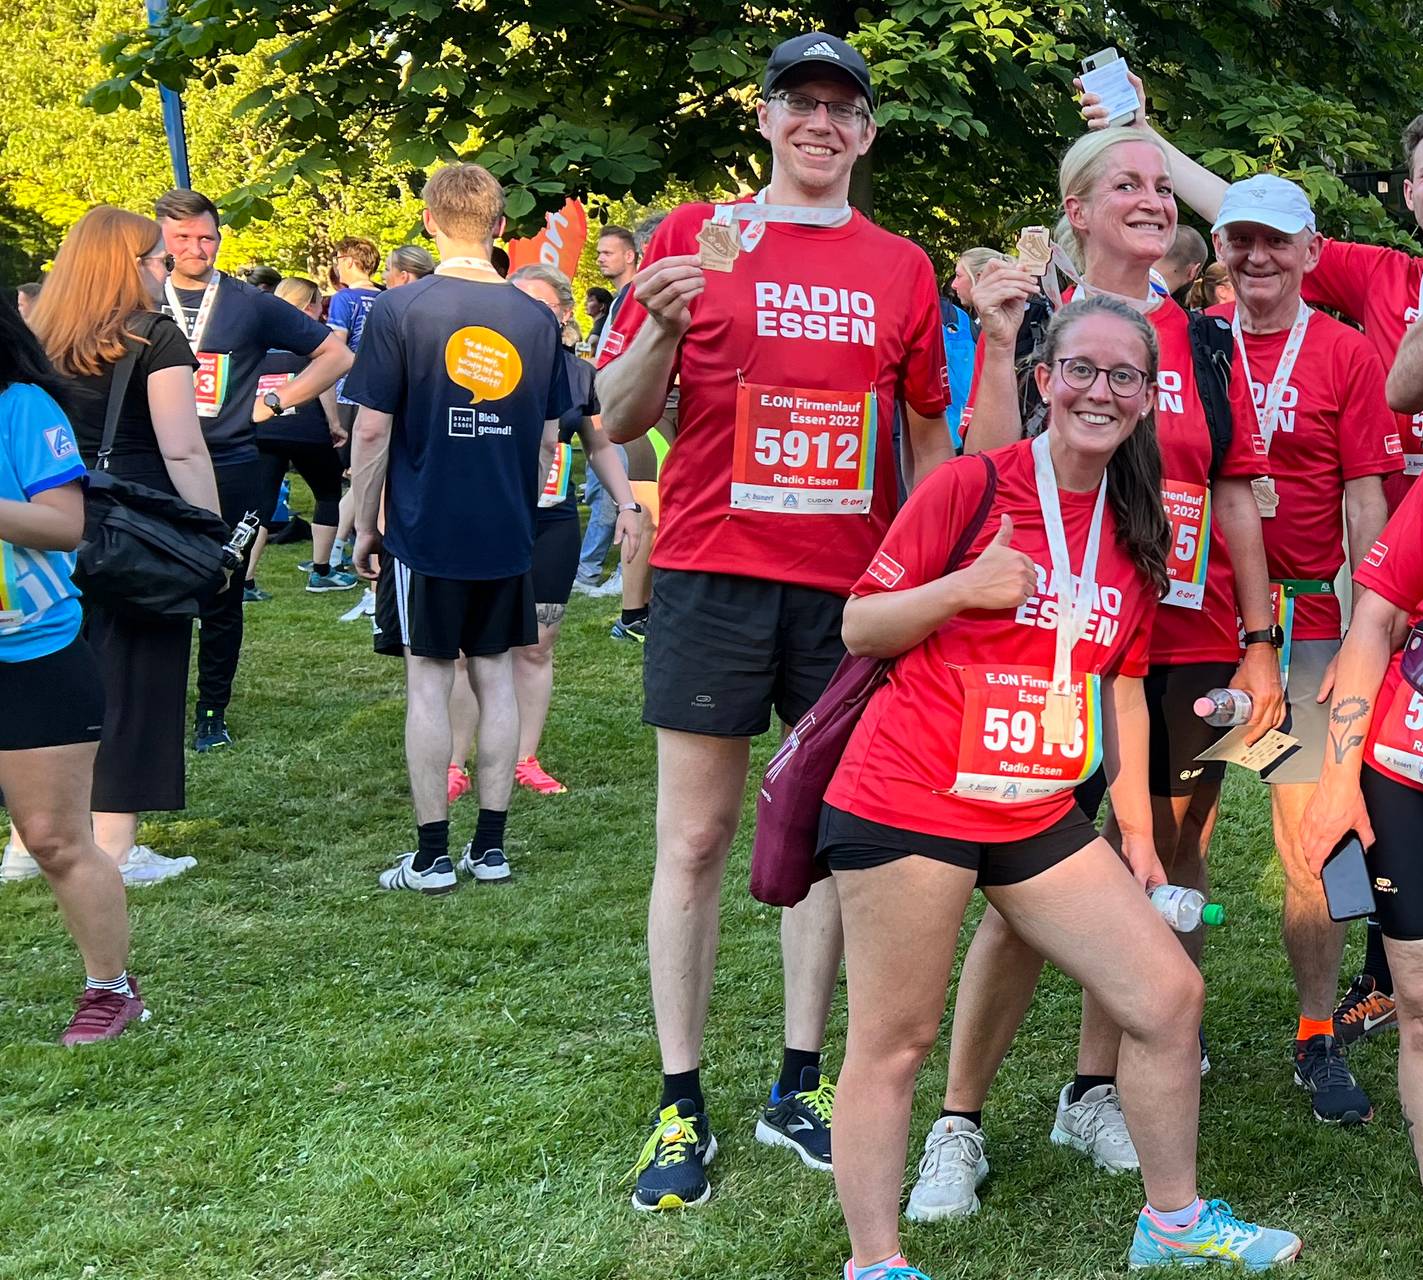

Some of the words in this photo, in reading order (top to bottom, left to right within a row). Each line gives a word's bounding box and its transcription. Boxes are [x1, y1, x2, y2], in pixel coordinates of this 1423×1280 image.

[803, 49, 840, 60] adidas
[755, 282, 875, 318] RADIO
[757, 310, 876, 346] ESSEN
[760, 394, 793, 408] E.ON
[796, 398, 861, 413] Firmenlauf
[478, 412, 500, 423] Bleib
[790, 412, 826, 425] Essen
[829, 414, 860, 427] 2022
[478, 425, 512, 436] gesund!
[754, 427, 859, 470] 5912
[773, 473, 805, 486] Radio
[808, 476, 839, 486] Essen
[1173, 504, 1200, 520] 2022
[985, 673, 1019, 686] E.ON
[1000, 761, 1030, 774] Radio
[1032, 763, 1063, 776] Essen
